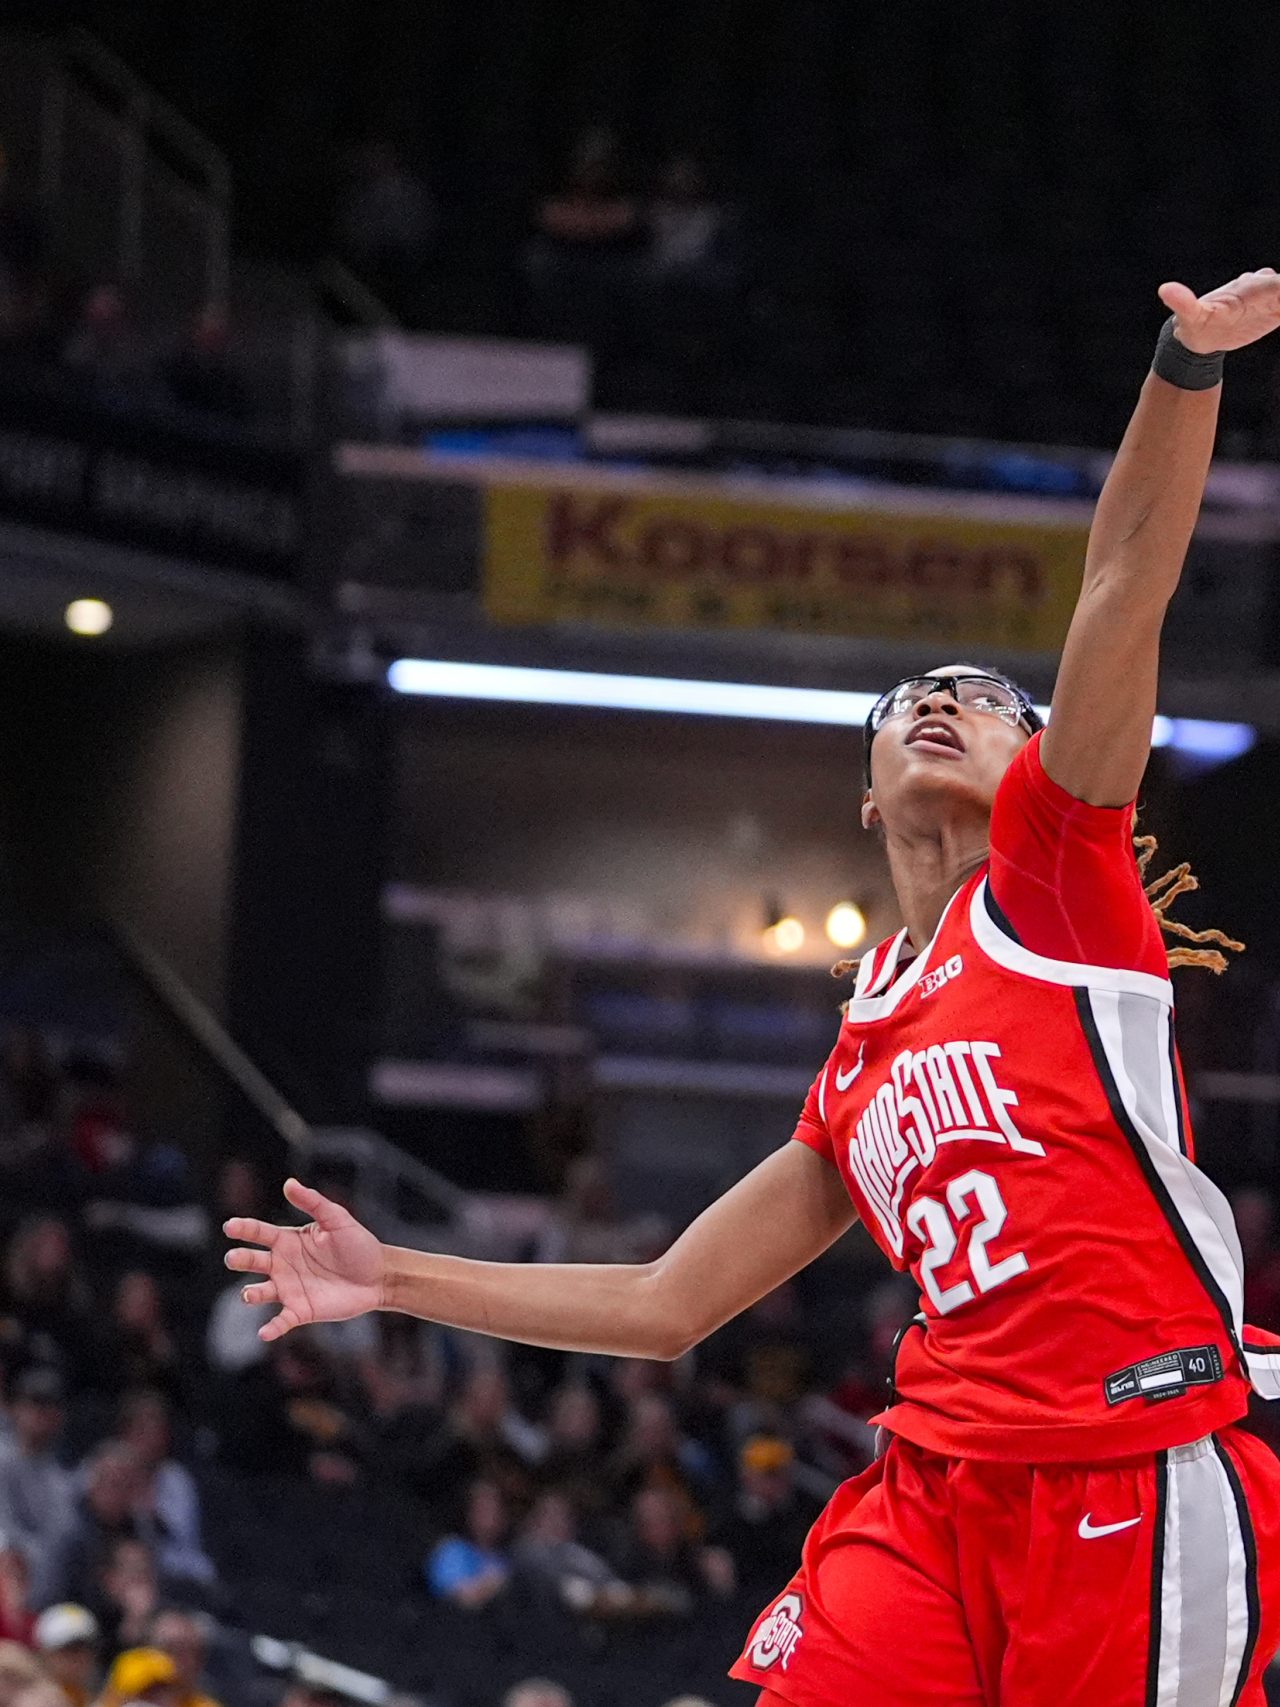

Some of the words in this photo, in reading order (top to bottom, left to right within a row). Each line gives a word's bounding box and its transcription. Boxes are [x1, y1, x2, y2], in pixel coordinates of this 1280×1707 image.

[547, 491, 1046, 606] Koorsen
[891, 1041, 1047, 1168] STATE
[907, 1169, 1030, 1316] 22
[1188, 1357, 1206, 1373] 40
